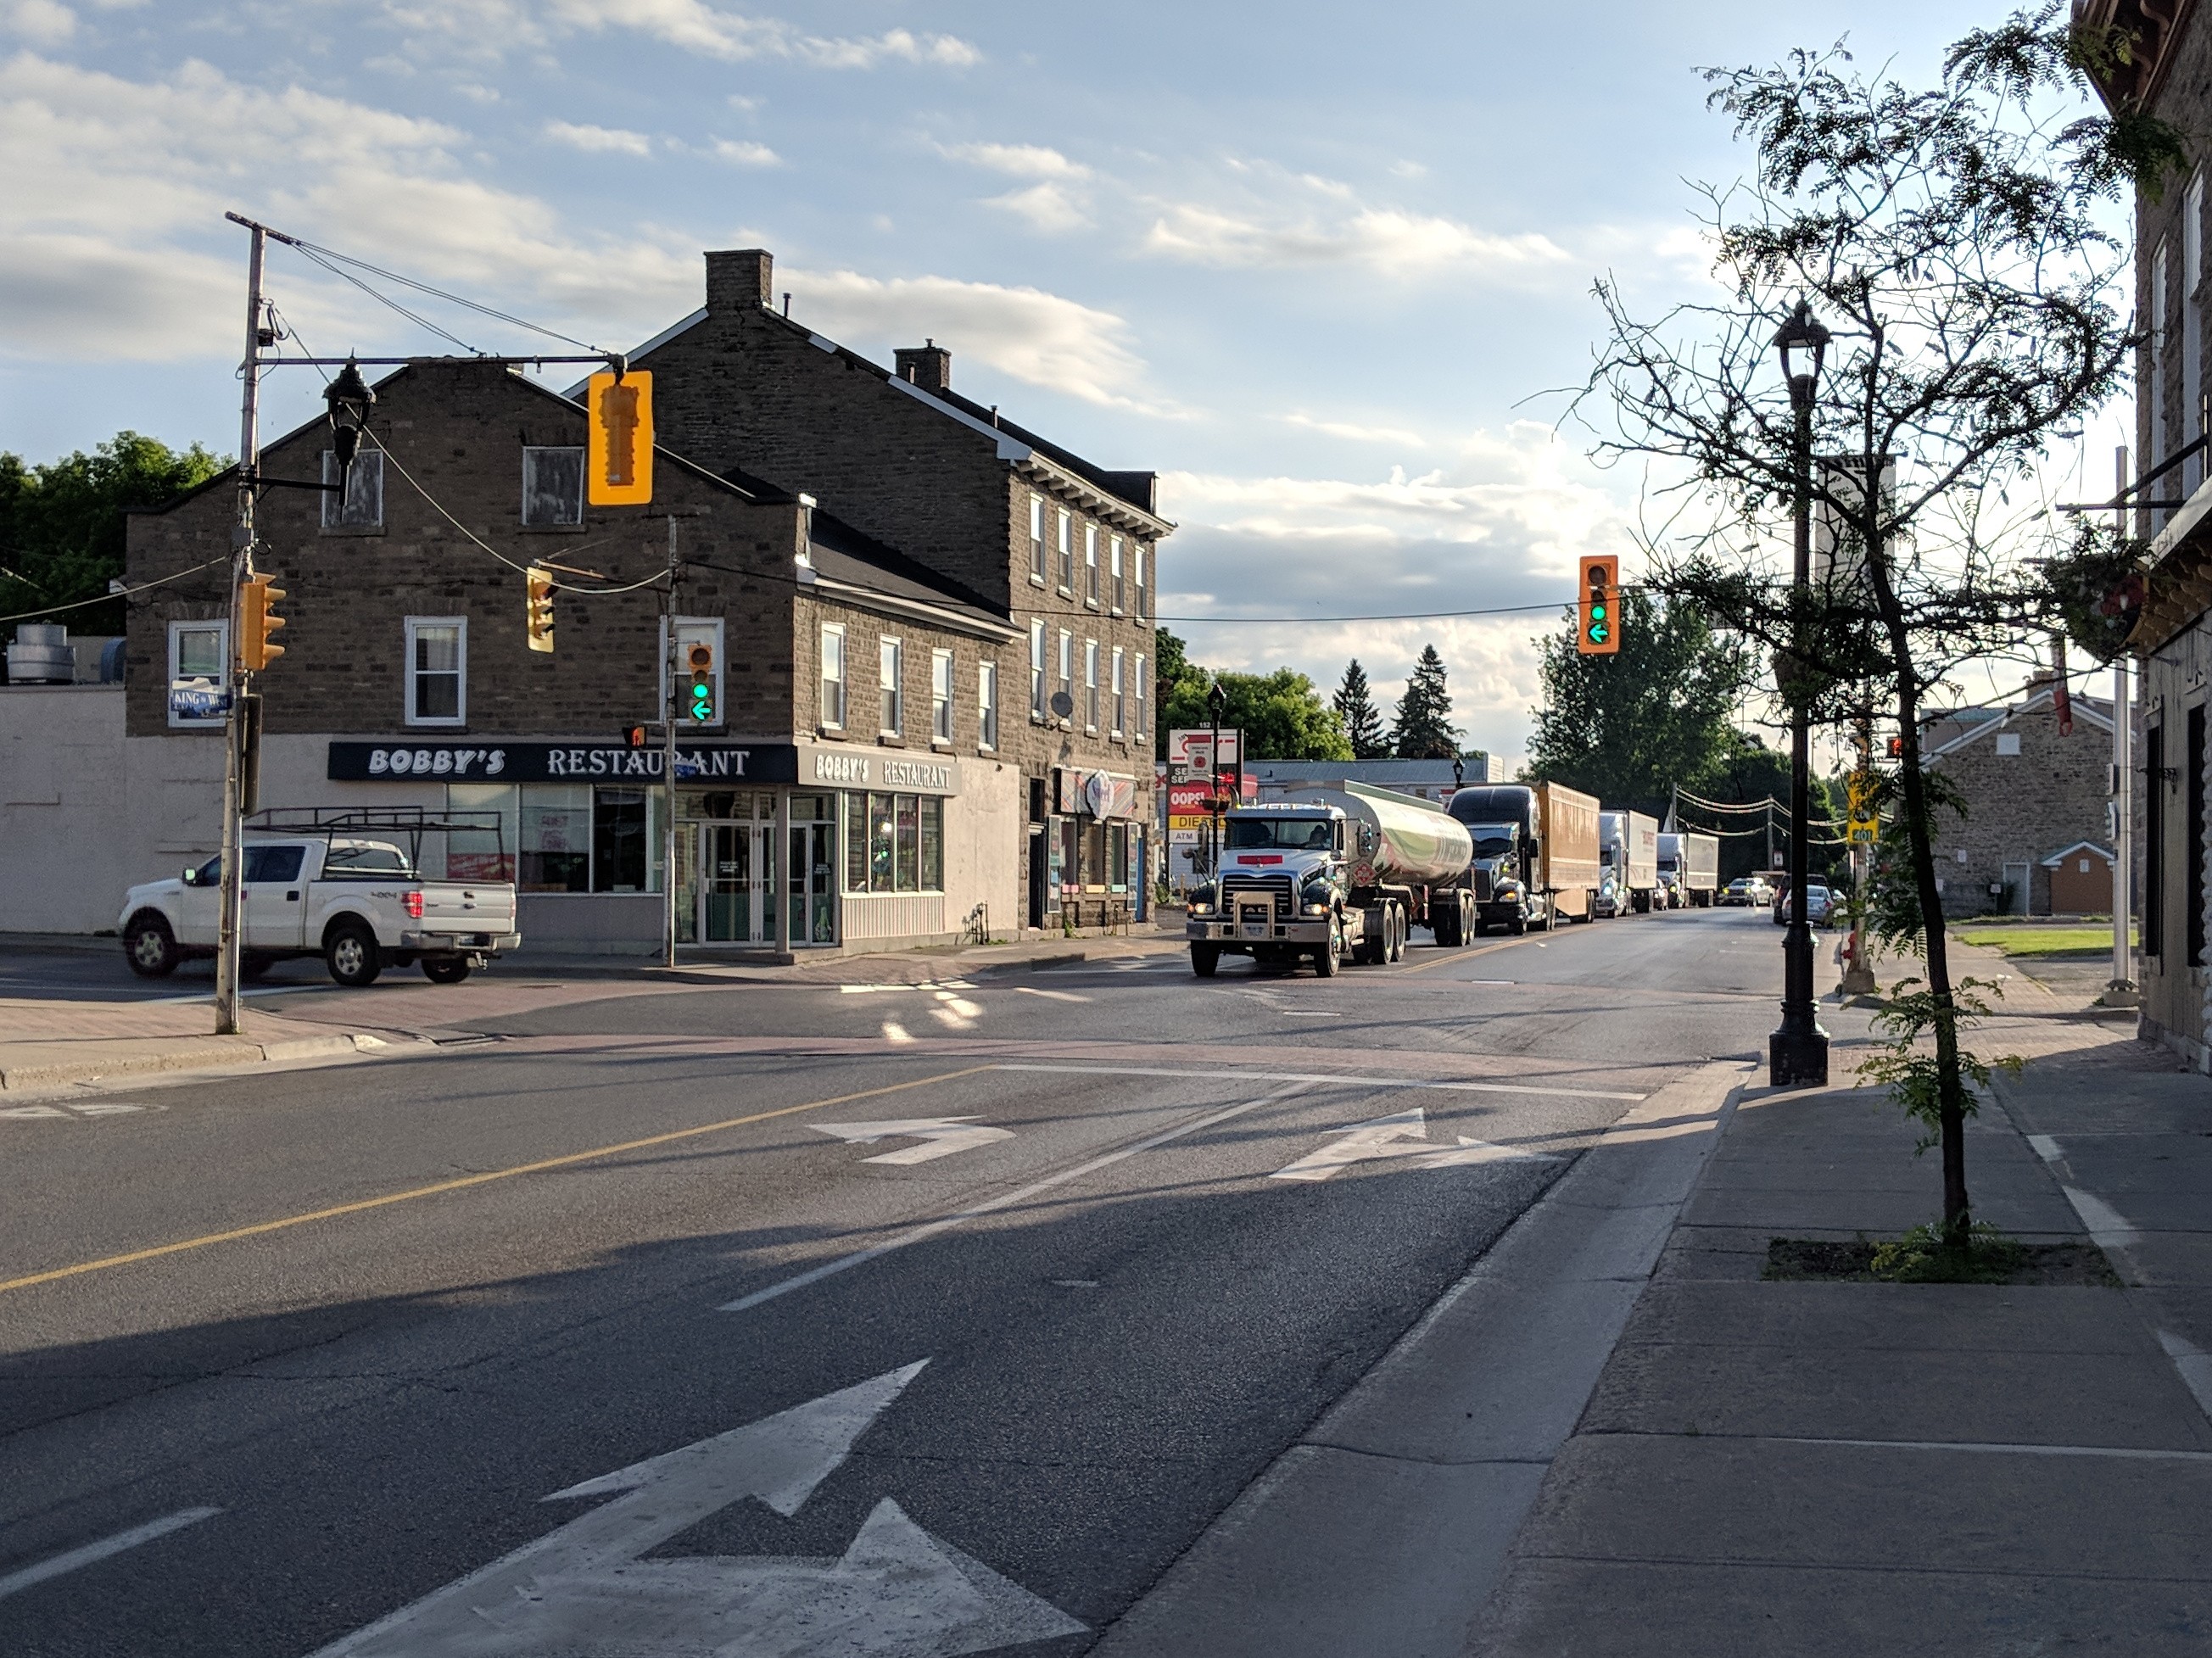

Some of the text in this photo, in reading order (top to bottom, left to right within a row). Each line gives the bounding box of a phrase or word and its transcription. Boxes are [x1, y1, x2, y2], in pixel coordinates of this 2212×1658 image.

[175, 691, 200, 706] KING
[369, 750, 506, 774] BOBBY'S
[816, 754, 951, 789] BOBBY'S RESTAURANT
[1854, 830, 1871, 840] 401
